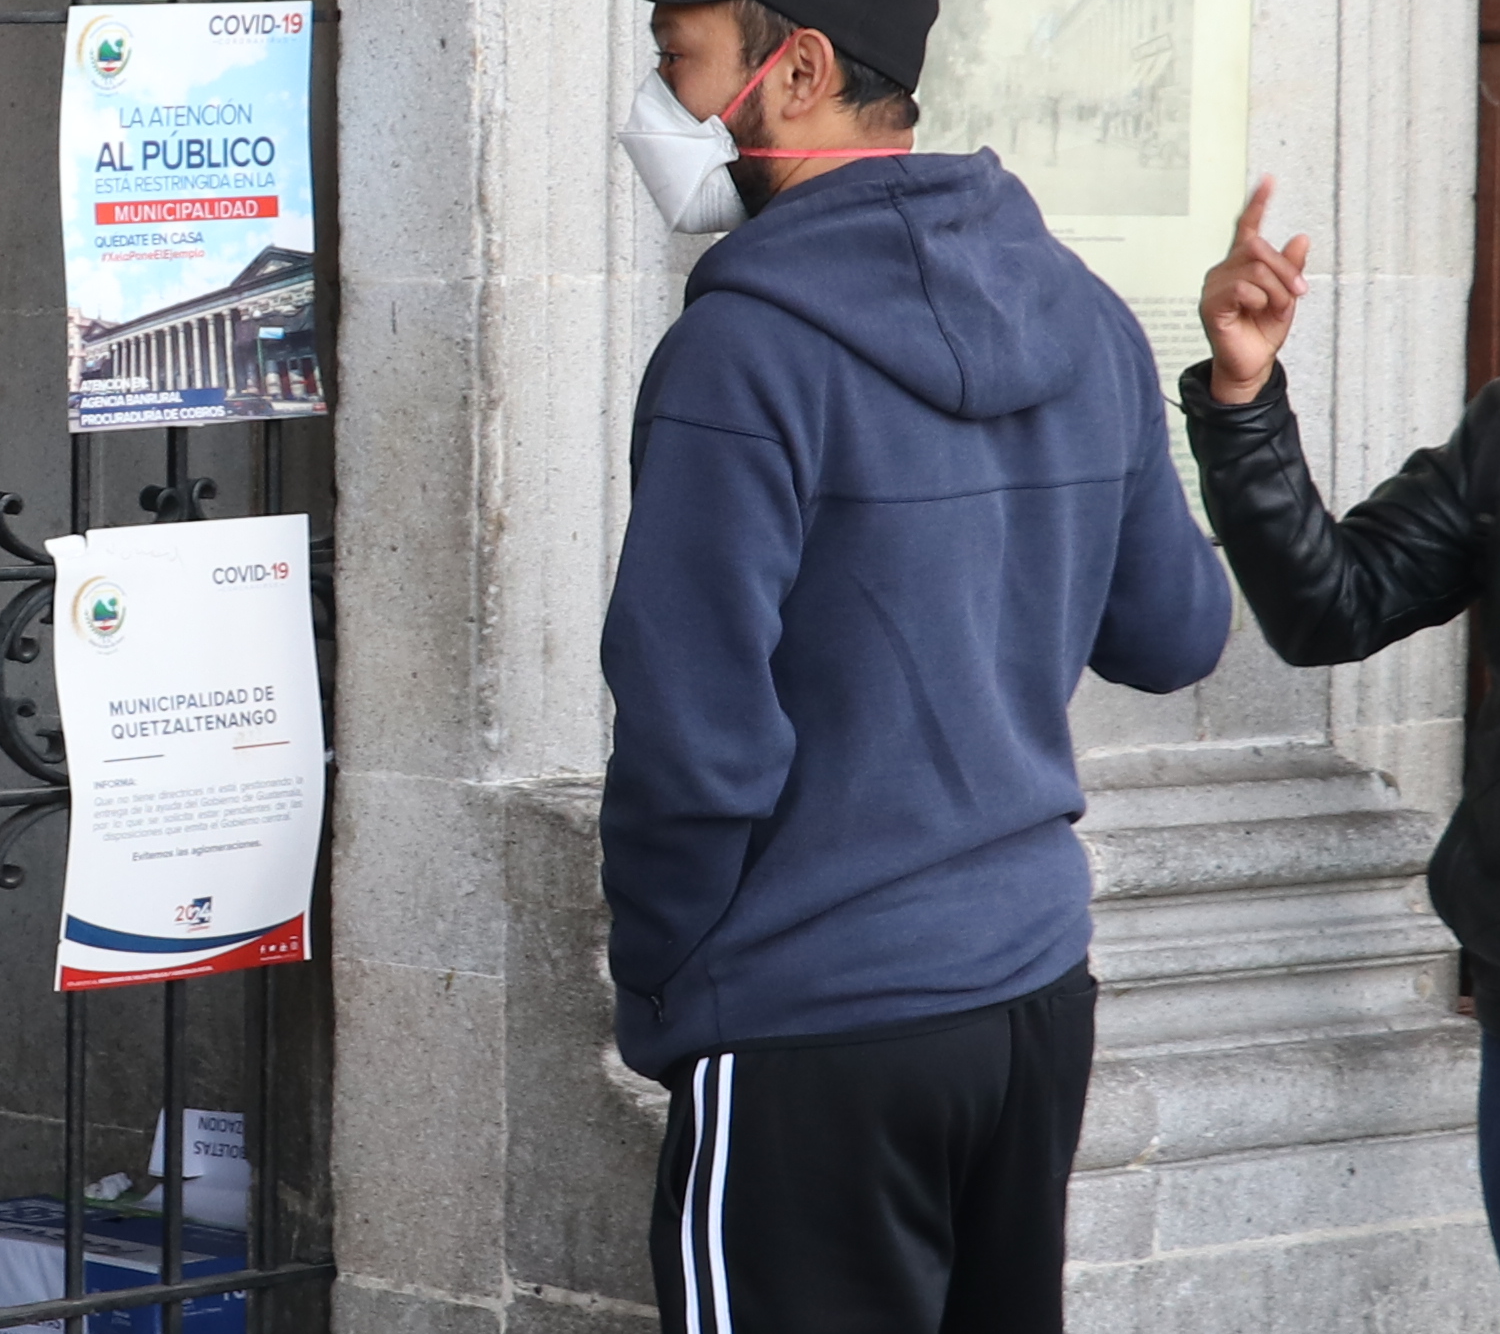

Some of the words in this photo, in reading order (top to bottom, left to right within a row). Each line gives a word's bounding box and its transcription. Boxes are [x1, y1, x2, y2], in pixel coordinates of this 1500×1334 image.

[209, 13, 304, 36] COVID-19
[119, 106, 145, 130] LA
[148, 98, 253, 128] ATENCIÓN
[95, 141, 134, 173] AL
[141, 130, 276, 170] PÚBLICO
[94, 173, 132, 194] ESTÁ
[135, 173, 232, 193] RESTRINGIDA
[236, 173, 254, 189] EN
[257, 172, 276, 188] LA
[113, 199, 259, 222] MUNICIPALIDAD
[152, 234, 168, 246] EN
[170, 232, 205, 245] CASA
[80, 394, 124, 409] AGENCIA
[126, 390, 183, 405] BANRURAL
[164, 409, 178, 420] DE
[179, 406, 226, 419] COBROS
[212, 562, 289, 585] COVID-19
[109, 688, 249, 718] MUNICIPALIDAD
[253, 685, 275, 703] DE
[111, 708, 277, 740] QUETZALTENANGO
[93, 777, 137, 791] INFORMA:
[131, 848, 174, 862] Evitemos
[175, 846, 190, 857] las
